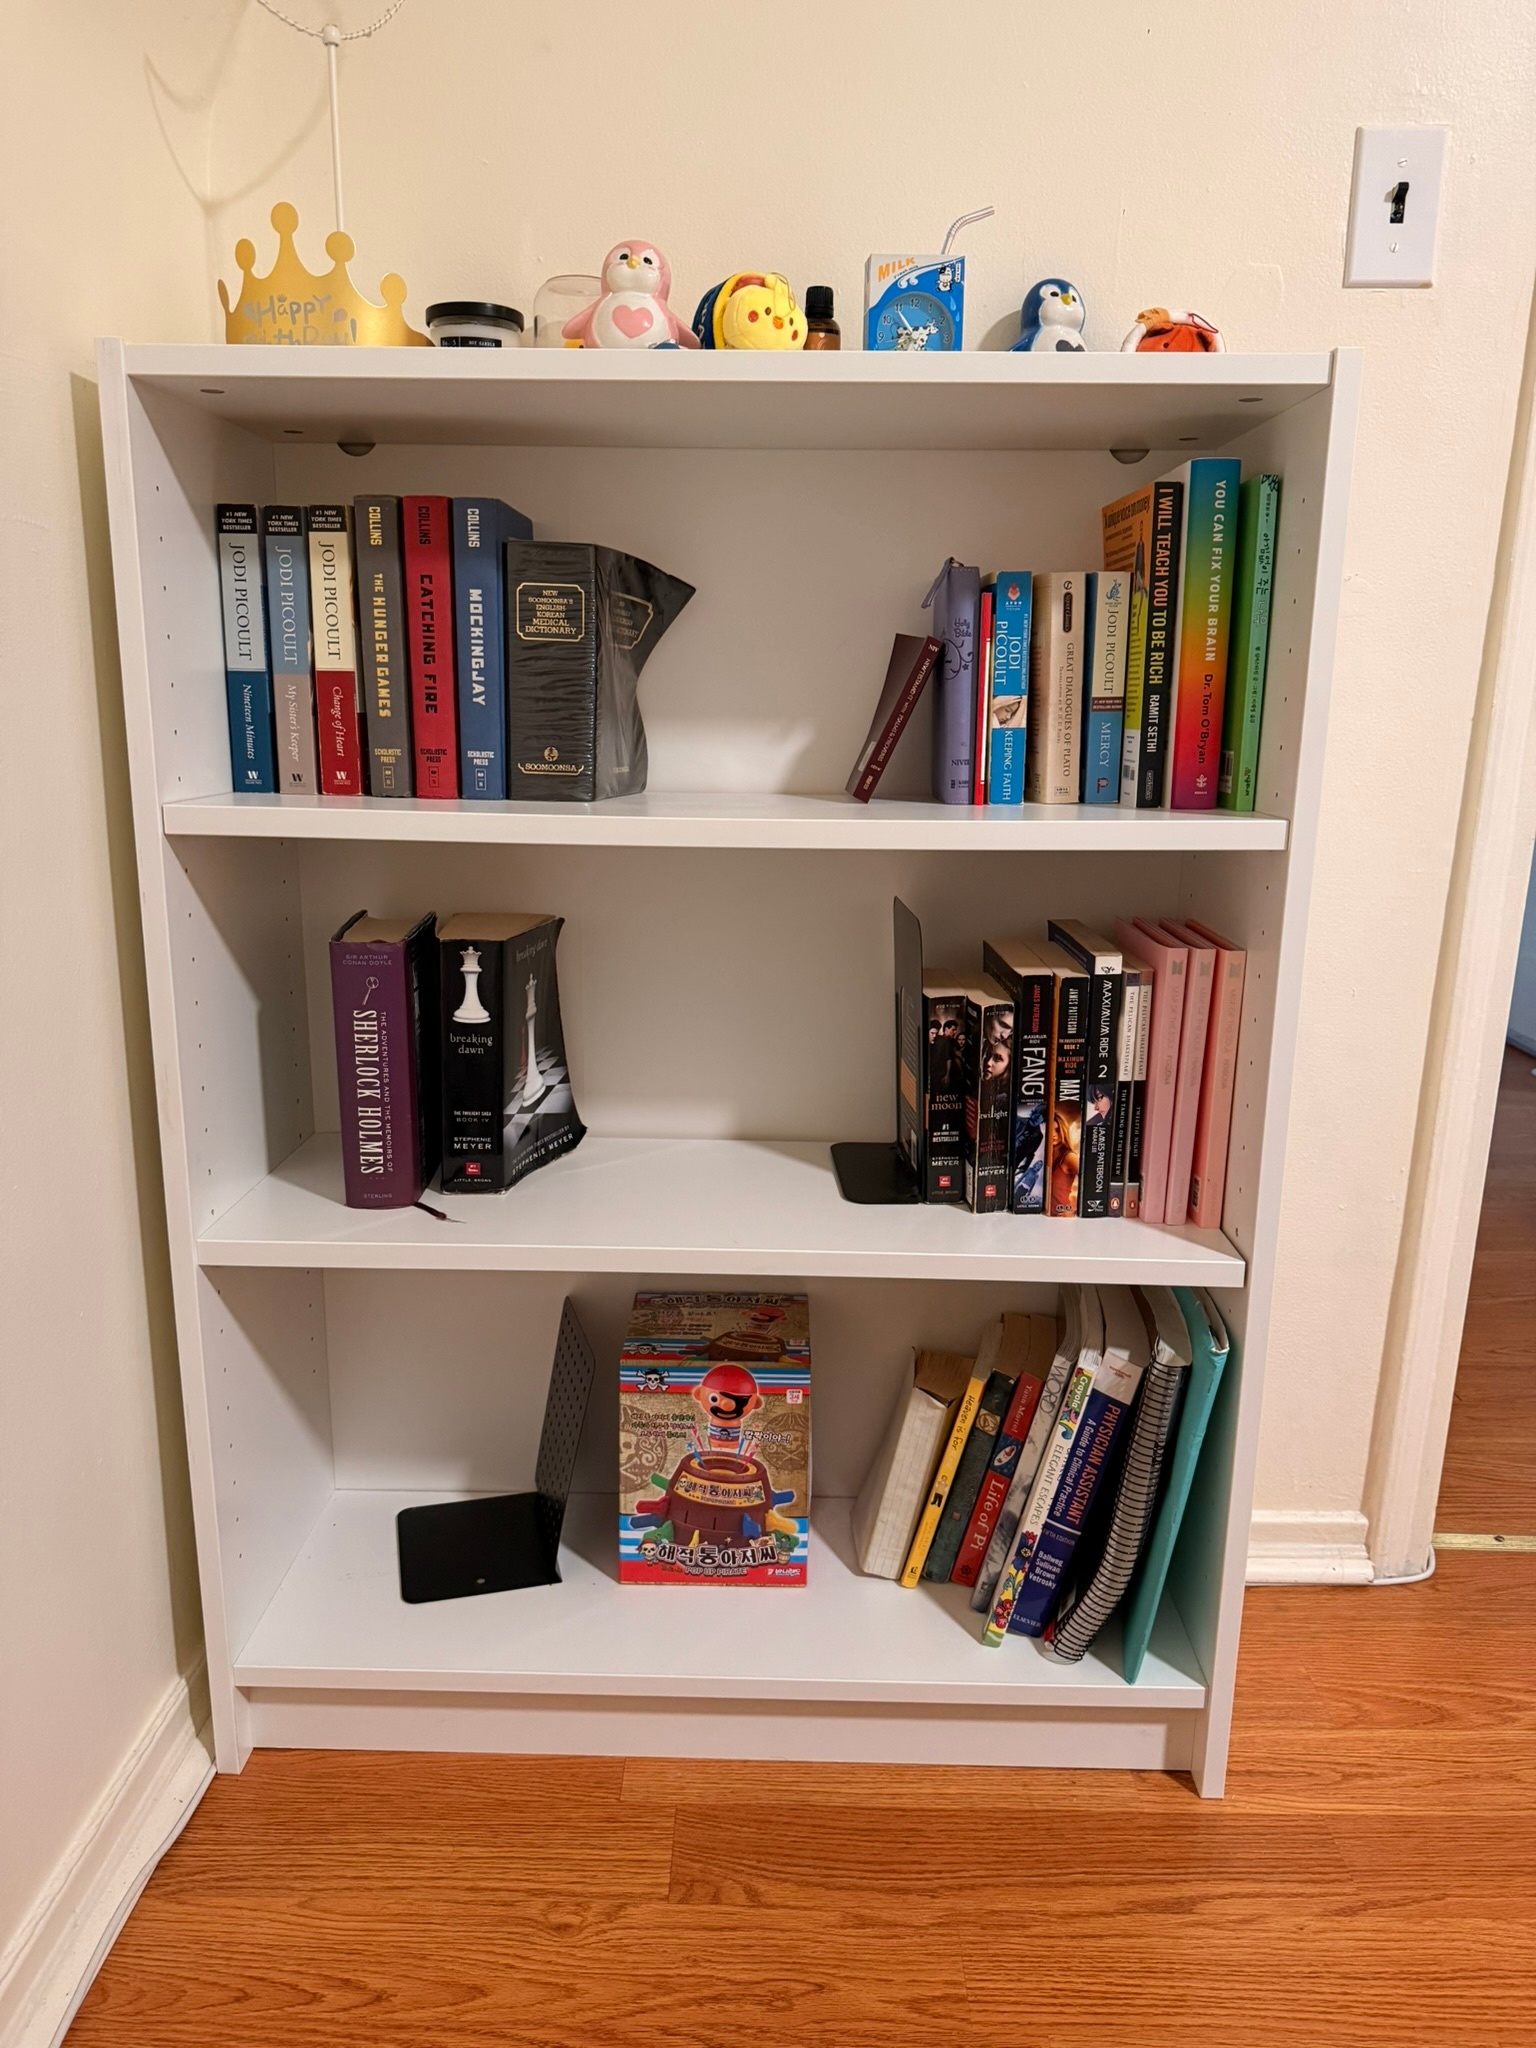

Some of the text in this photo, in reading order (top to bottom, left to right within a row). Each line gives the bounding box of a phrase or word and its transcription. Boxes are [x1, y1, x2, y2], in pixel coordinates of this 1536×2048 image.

[878, 257, 915, 283] MILK
[883, 315, 891, 324] 10
[911, 298, 920, 308] 12
[878, 332, 884, 342] 9
[369, 506, 382, 546] COLLINS
[418, 506, 431, 545] COLLINS
[467, 508, 480, 548] COLLINS
[1158, 495, 1173, 530] WILL
[1155, 532, 1172, 577] TEACH
[1205, 480, 1227, 662] YOU CAN FIX YOUR BRAIN
[228, 542, 253, 661] JODI PICOULT
[275, 546, 298, 665] JODI PICOULT
[318, 541, 341, 660] JODI PICOULT
[1154, 579, 1169, 607] YOU
[525, 625, 576, 635] DICTIONARY
[532, 618, 569, 626] MEDICAL
[536, 611, 566, 619] KOREAN
[1107, 609, 1119, 637] JODI
[1152, 610, 1167, 627] TO
[373, 573, 391, 718] THE HUNGER GAMES
[420, 574, 438, 714] CATCHING FIRE
[469, 588, 486, 706] MOCKINGJAY
[995, 621, 1008, 685] PICOULT
[1008, 636, 1022, 669] JODI
[1150, 630, 1165, 649] BE
[1104, 642, 1116, 694] PICOULT
[1149, 652, 1164, 685] RICH
[243, 684, 255, 760] Nineteen Minutes
[285, 684, 300, 762] My Sister's Keeper
[331, 686, 346, 757] Change of Heart
[1063, 642, 1074, 777] GREAT DIALOGUES OF PLATO
[1146, 694, 1160, 753] RAMIT SETHI
[1197, 674, 1214, 764] Dr. Tom O'Bryan
[374, 748, 402, 756] SCHOLASTIC
[420, 748, 447, 756] SCHOLASTIC
[467, 750, 495, 759] SCHOLASTIC
[1100, 722, 1111, 767] MERCY
[473, 758, 489, 766] PRESS
[525, 763, 577, 772] SOOMOONSA
[1002, 730, 1014, 801] KEEPING FAITH
[1032, 1003, 1040, 1033] PATTERSON
[1067, 988, 1079, 1034] JAMES PATTERSON
[450, 1033, 493, 1046] breaking
[1098, 979, 1113, 1078] MAXIMUM RIDE 2
[382, 1030, 390, 1084] ADVENTURES
[458, 1044, 484, 1054] dawn
[1123, 1035, 1132, 1076] SHAKESPEARE
[1021, 1047, 1046, 1096] FANG
[352, 1009, 384, 1175] SHERLOCK HOLMES
[931, 1102, 962, 1111] moon
[936, 1094, 958, 1102] new
[1059, 1079, 1081, 1102] MAX
[980, 1105, 1008, 1120] twilight
[385, 1123, 393, 1160] MEMOIRS
[1097, 1127, 1106, 1153] JAMES
[1119, 1130, 1124, 1138] OF
[387, 1162, 393, 1173] OF
[512, 1148, 546, 1175] STEPHENIE
[548, 1133, 574, 1151] MEYER
[1095, 1153, 1106, 1193] PATTERSON
[1039, 1363, 1068, 1414] WORD
[1072, 1376, 1088, 1409] Crayola
[951, 1395, 976, 1451] Heaven is for
[1013, 1385, 1033, 1433] Yann Martel
[1087, 1418, 1097, 1427] A
[1079, 1427, 1095, 1448] Guide
[1088, 1404, 1121, 1466] PHYSICIAN
[1075, 1448, 1085, 1457] to
[1030, 1444, 1064, 1526] ELEGANT ESCAPES
[1066, 1455, 1084, 1487] Clinical
[1053, 1487, 1075, 1518] Practice
[1066, 1466, 1099, 1526] ASSISTANT
[970, 1477, 1006, 1551] Life of Pi
[658, 1543, 778, 1567] 해적통아저씨
[1035, 1559, 1061, 1573] Sullivan
[1038, 1550, 1064, 1568] Ballweg
[1029, 1572, 1057, 1590] Vetrosky
[1035, 1567, 1056, 1580] Brown
[1013, 1614, 1042, 1628] ELSEVIER
